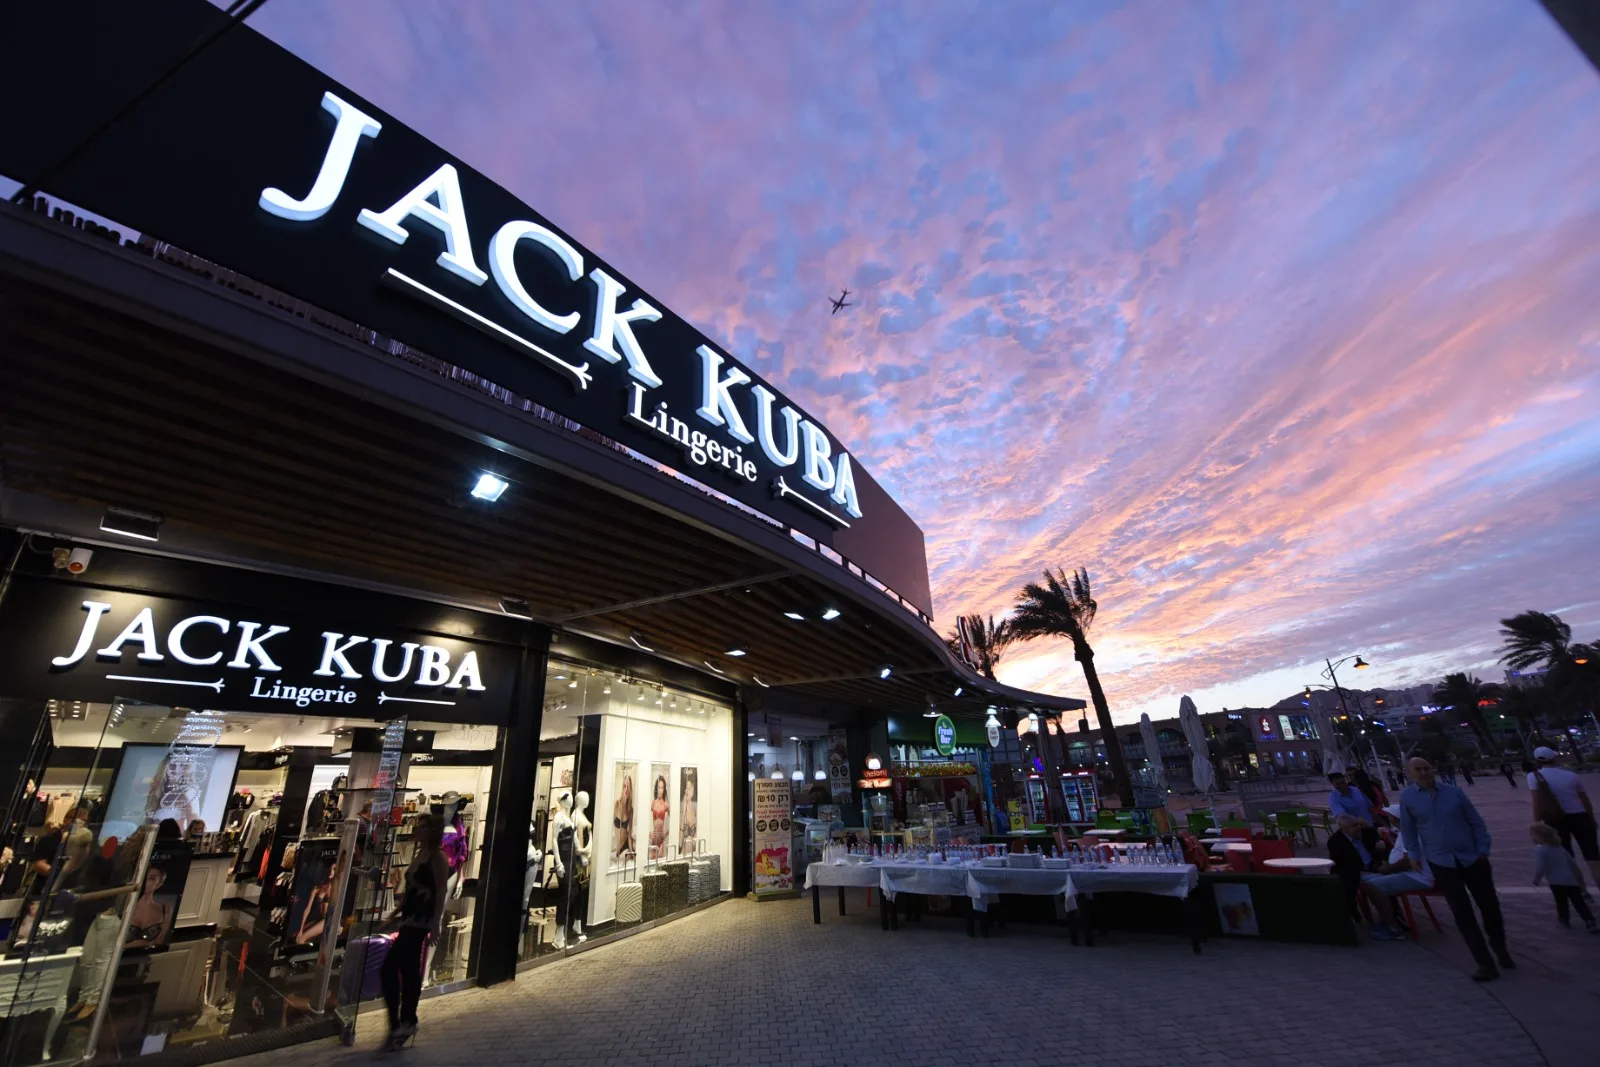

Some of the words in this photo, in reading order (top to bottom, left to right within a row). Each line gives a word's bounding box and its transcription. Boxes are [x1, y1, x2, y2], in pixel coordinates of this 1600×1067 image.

[257, 91, 663, 389] JACK
[696, 343, 863, 519] KUBA
[627, 381, 758, 482] Lingerie
[51, 600, 290, 671] JACK
[314, 632, 487, 691] KUBA
[250, 677, 357, 706] Lingerie
[938, 726, 953, 735] Fresh
[778, 794, 788, 804] רק
